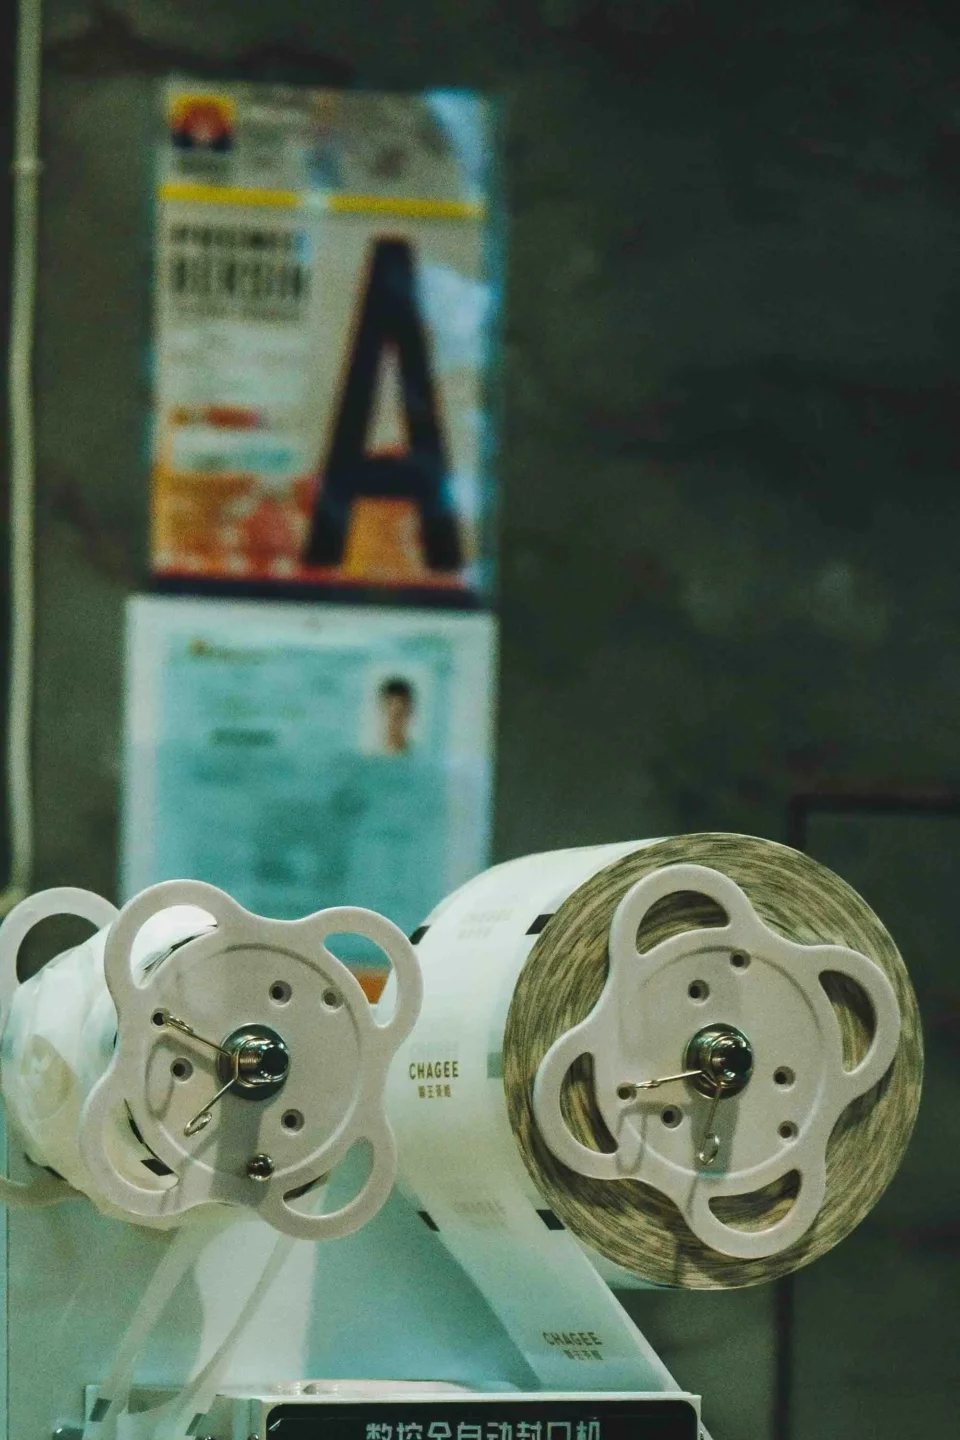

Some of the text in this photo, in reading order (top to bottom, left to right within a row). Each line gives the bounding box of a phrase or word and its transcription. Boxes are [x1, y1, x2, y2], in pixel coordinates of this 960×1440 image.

[302, 235, 464, 572] A
[410, 1060, 460, 1080] CHAGEE
[542, 1331, 604, 1346] CHAGEE
